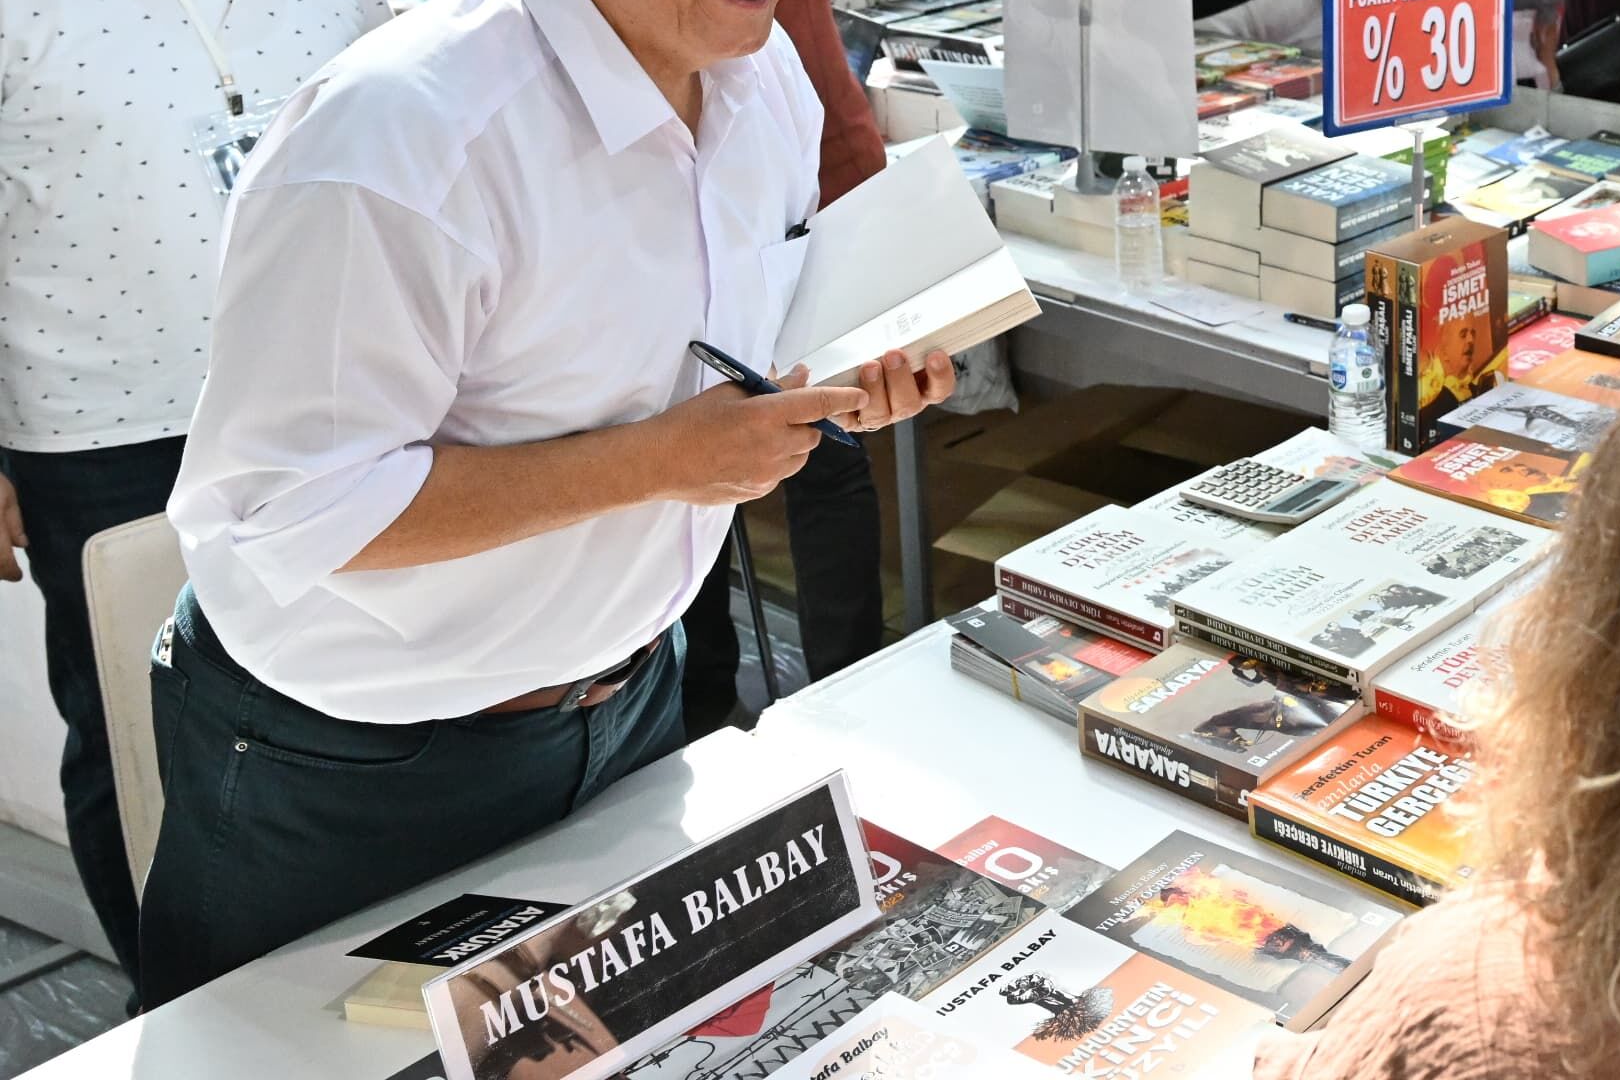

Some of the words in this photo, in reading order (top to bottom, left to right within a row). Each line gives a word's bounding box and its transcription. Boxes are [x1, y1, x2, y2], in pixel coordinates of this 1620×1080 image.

[1420, 2, 1476, 91] 30
[1439, 289, 1490, 326] PAŞALI
[1442, 273, 1487, 306] İSMET
[1434, 444, 1493, 474] İSMET
[1451, 445, 1515, 482] PAŞALI
[1344, 506, 1394, 533] TÜRK
[1350, 506, 1417, 544] DEVRİM
[1370, 513, 1429, 546] TARİHİ
[1057, 529, 1113, 557] TÜRK
[1061, 529, 1137, 569] DEVRİM
[1079, 536, 1145, 571] TARİHİ
[1049, 591, 1079, 610] DEVRİM
[1079, 603, 1102, 619] TÜRK
[1234, 626, 1265, 646] DEVRİM
[1266, 639, 1289, 655] TÜRK
[1129, 658, 1220, 714] SAKARYA
[1095, 728, 1191, 788] SAKARYA
[1293, 759, 1357, 803] Şerafettin
[1353, 735, 1394, 765] Turan
[1327, 745, 1449, 822] TÜRKİYE
[1273, 818, 1320, 852] GERÇEĞİ
[1320, 839, 1367, 871] TÜRKİYE
[1372, 866, 1399, 887] Turan
[432, 905, 545, 962] ATATÜRK
[478, 911, 678, 1048] MUSTAFA
[680, 824, 829, 936] BALBAY
[1001, 928, 1058, 972] BALBAY
[839, 1026, 890, 1064] Balbay
